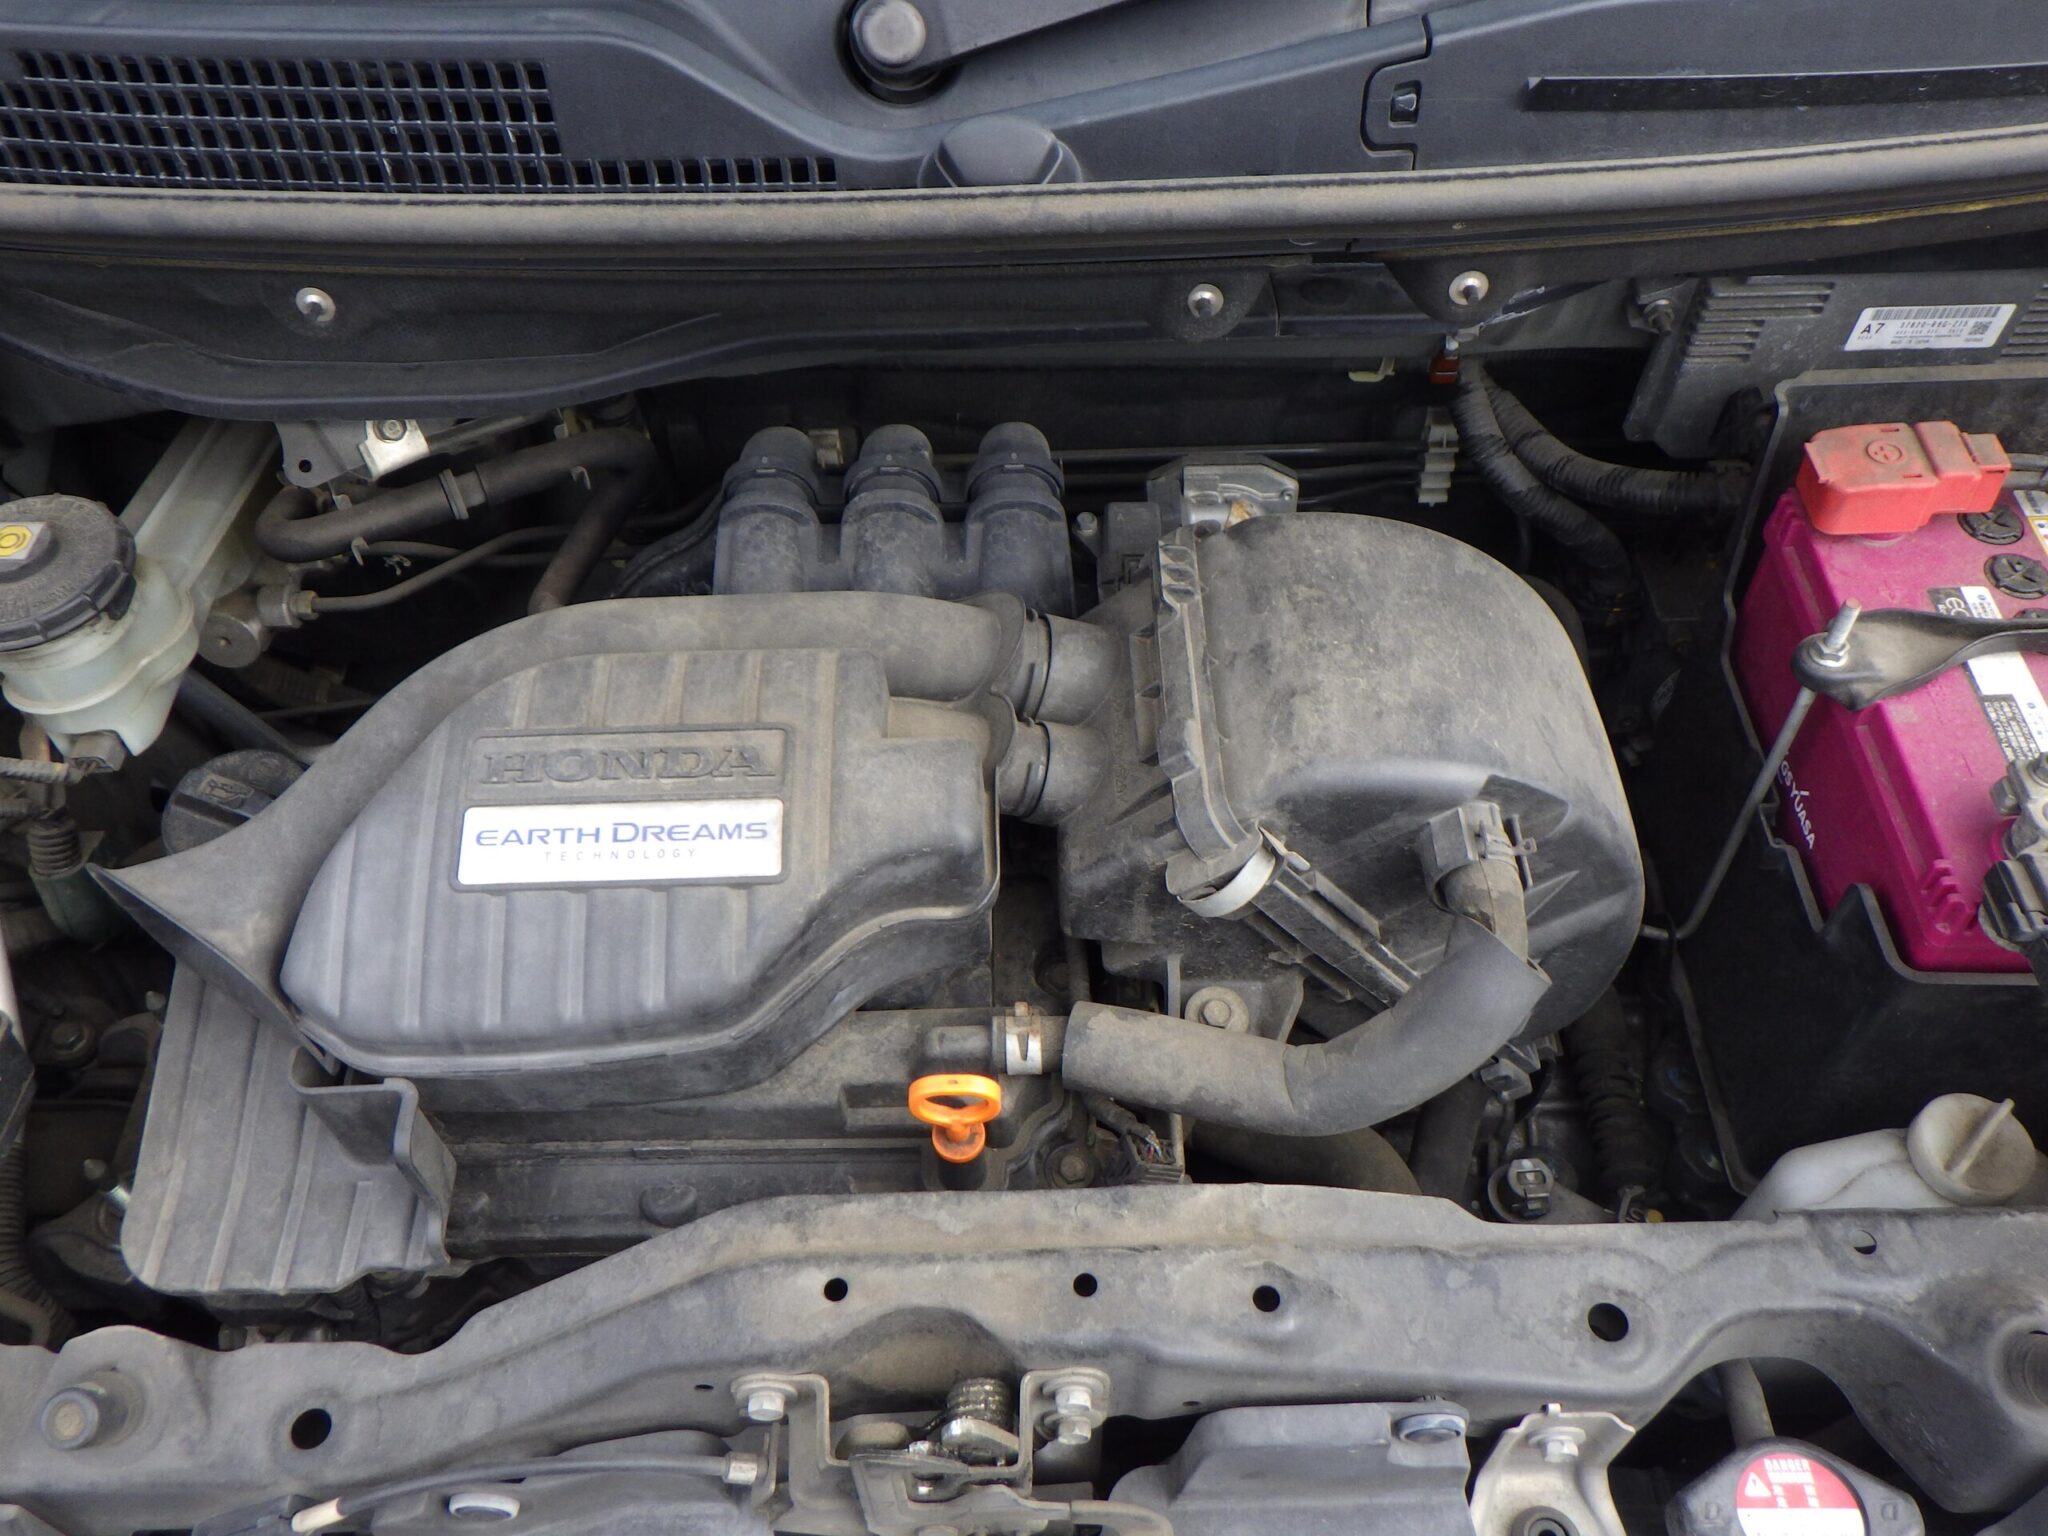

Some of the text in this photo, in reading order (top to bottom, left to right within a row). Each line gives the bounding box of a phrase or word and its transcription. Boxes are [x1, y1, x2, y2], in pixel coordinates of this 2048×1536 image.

[480, 745, 776, 784] HONDA
[475, 822, 769, 847] EARTH DREAMS
[545, 848, 697, 862] TECHNOLOGY
[1763, 1458, 1812, 1473] DANGER
